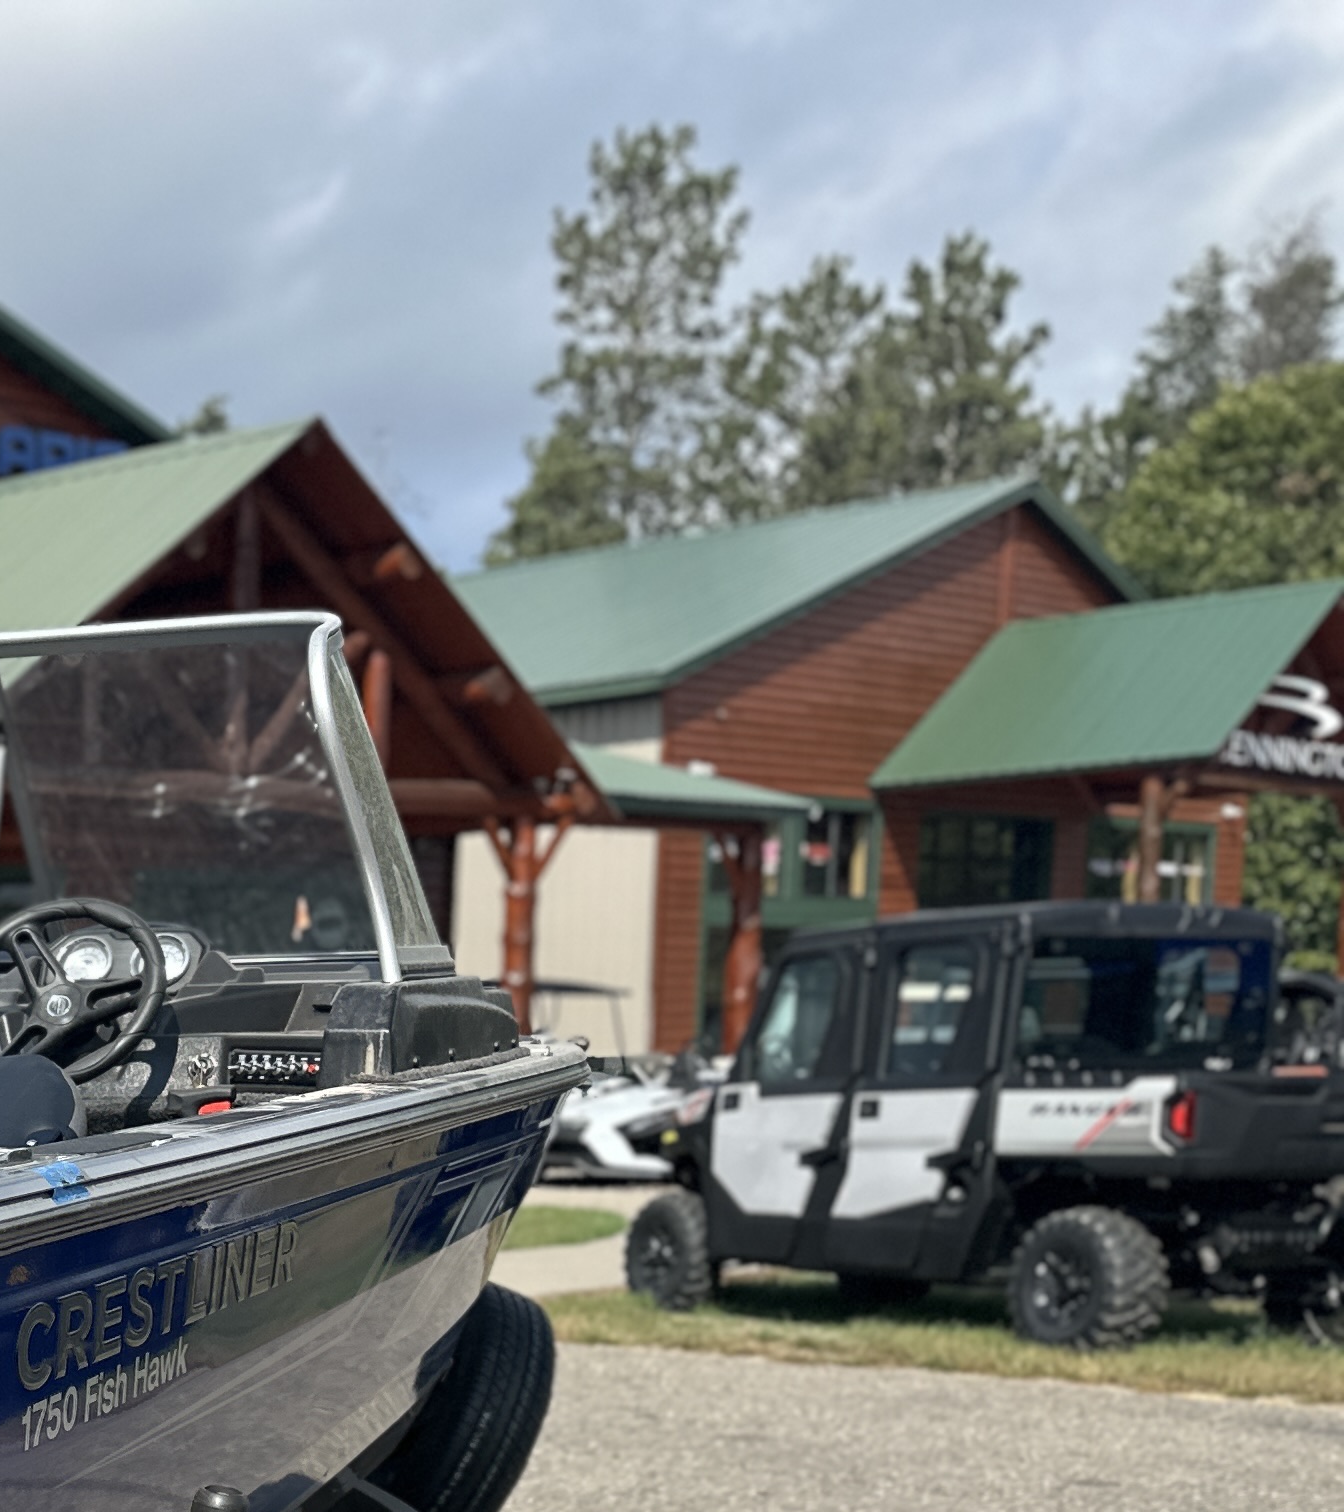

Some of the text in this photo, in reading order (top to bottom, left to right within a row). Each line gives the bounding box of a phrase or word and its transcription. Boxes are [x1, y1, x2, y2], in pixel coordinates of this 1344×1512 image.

[17, 1220, 300, 1391] CRESTLINER
[21, 1336, 188, 1451] 1750 Fish Hawk
